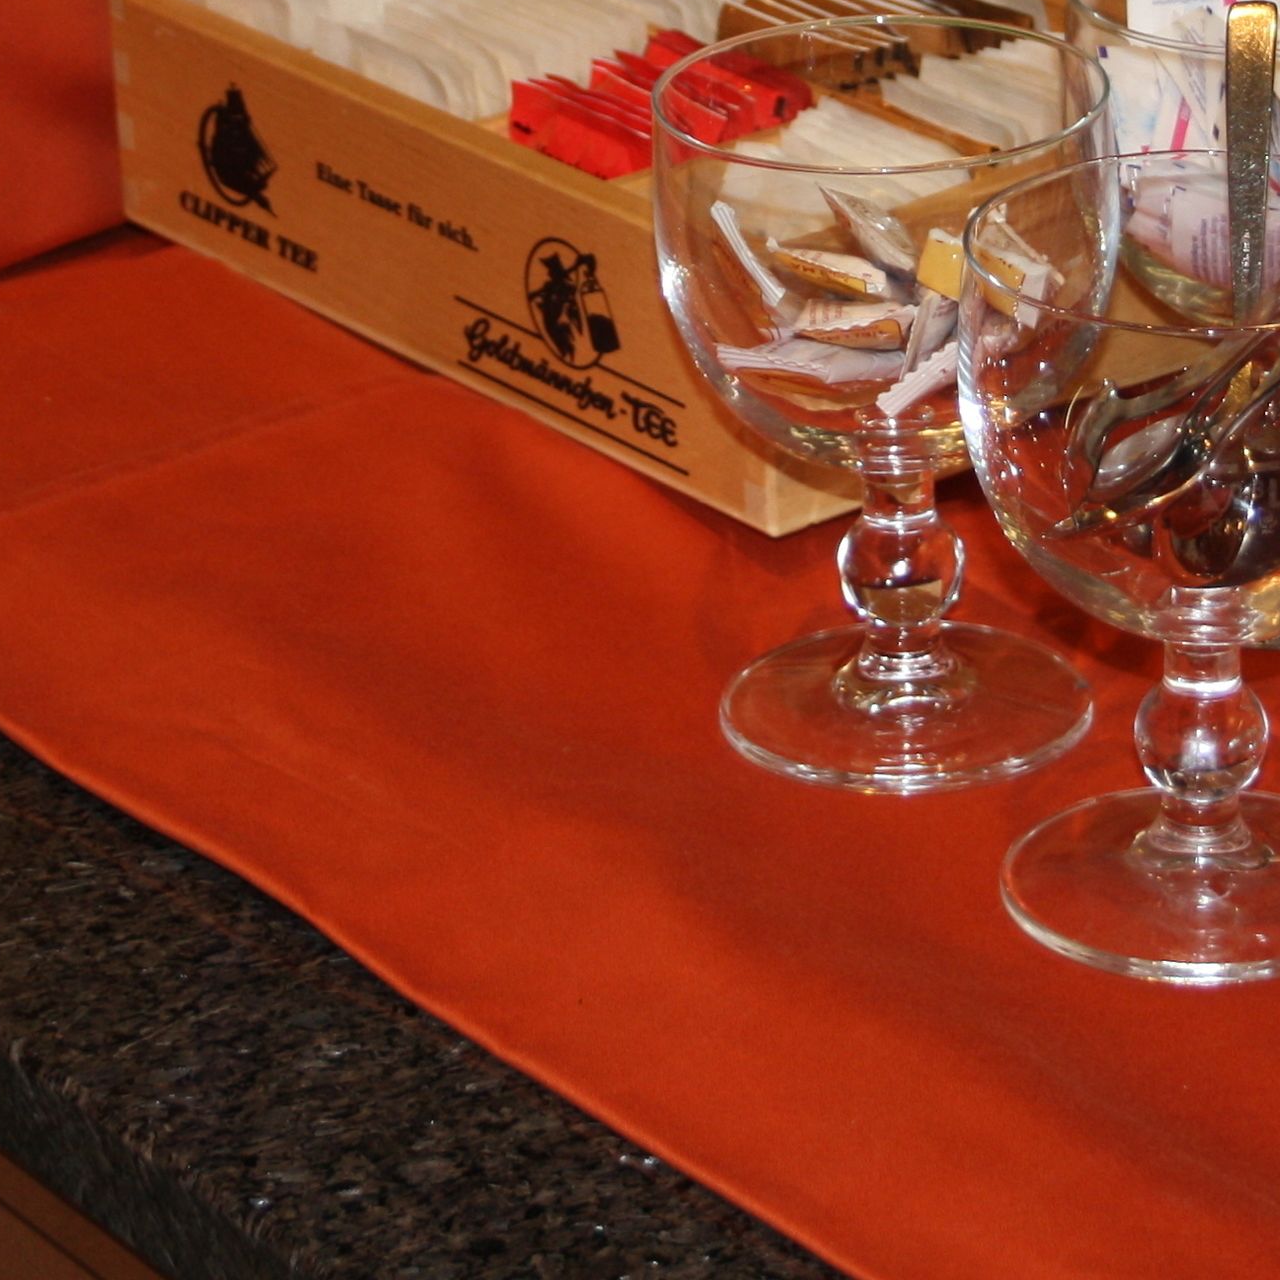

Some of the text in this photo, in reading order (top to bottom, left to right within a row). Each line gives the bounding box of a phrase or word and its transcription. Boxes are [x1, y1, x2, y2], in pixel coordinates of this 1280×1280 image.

[179, 190, 318, 273] CLIPPER TEE
[316, 161, 480, 253] Eine Tasse für sich.
